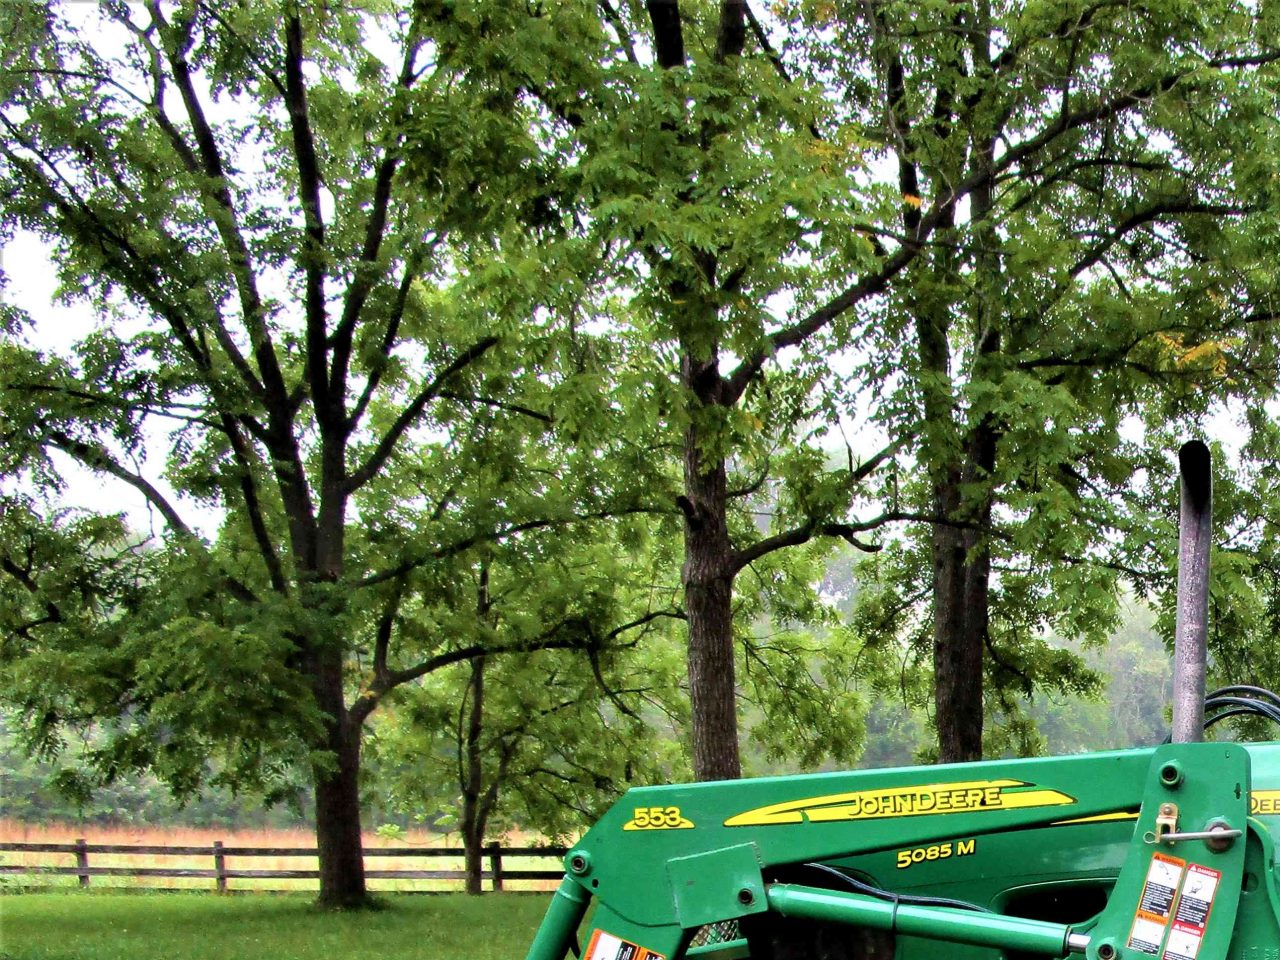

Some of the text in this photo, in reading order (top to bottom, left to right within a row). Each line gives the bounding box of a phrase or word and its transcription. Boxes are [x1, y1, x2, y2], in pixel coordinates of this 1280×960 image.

[848, 787, 1002, 816] JOHN DEERE
[634, 806, 682, 827] 553
[896, 839, 976, 869] 5085 M
